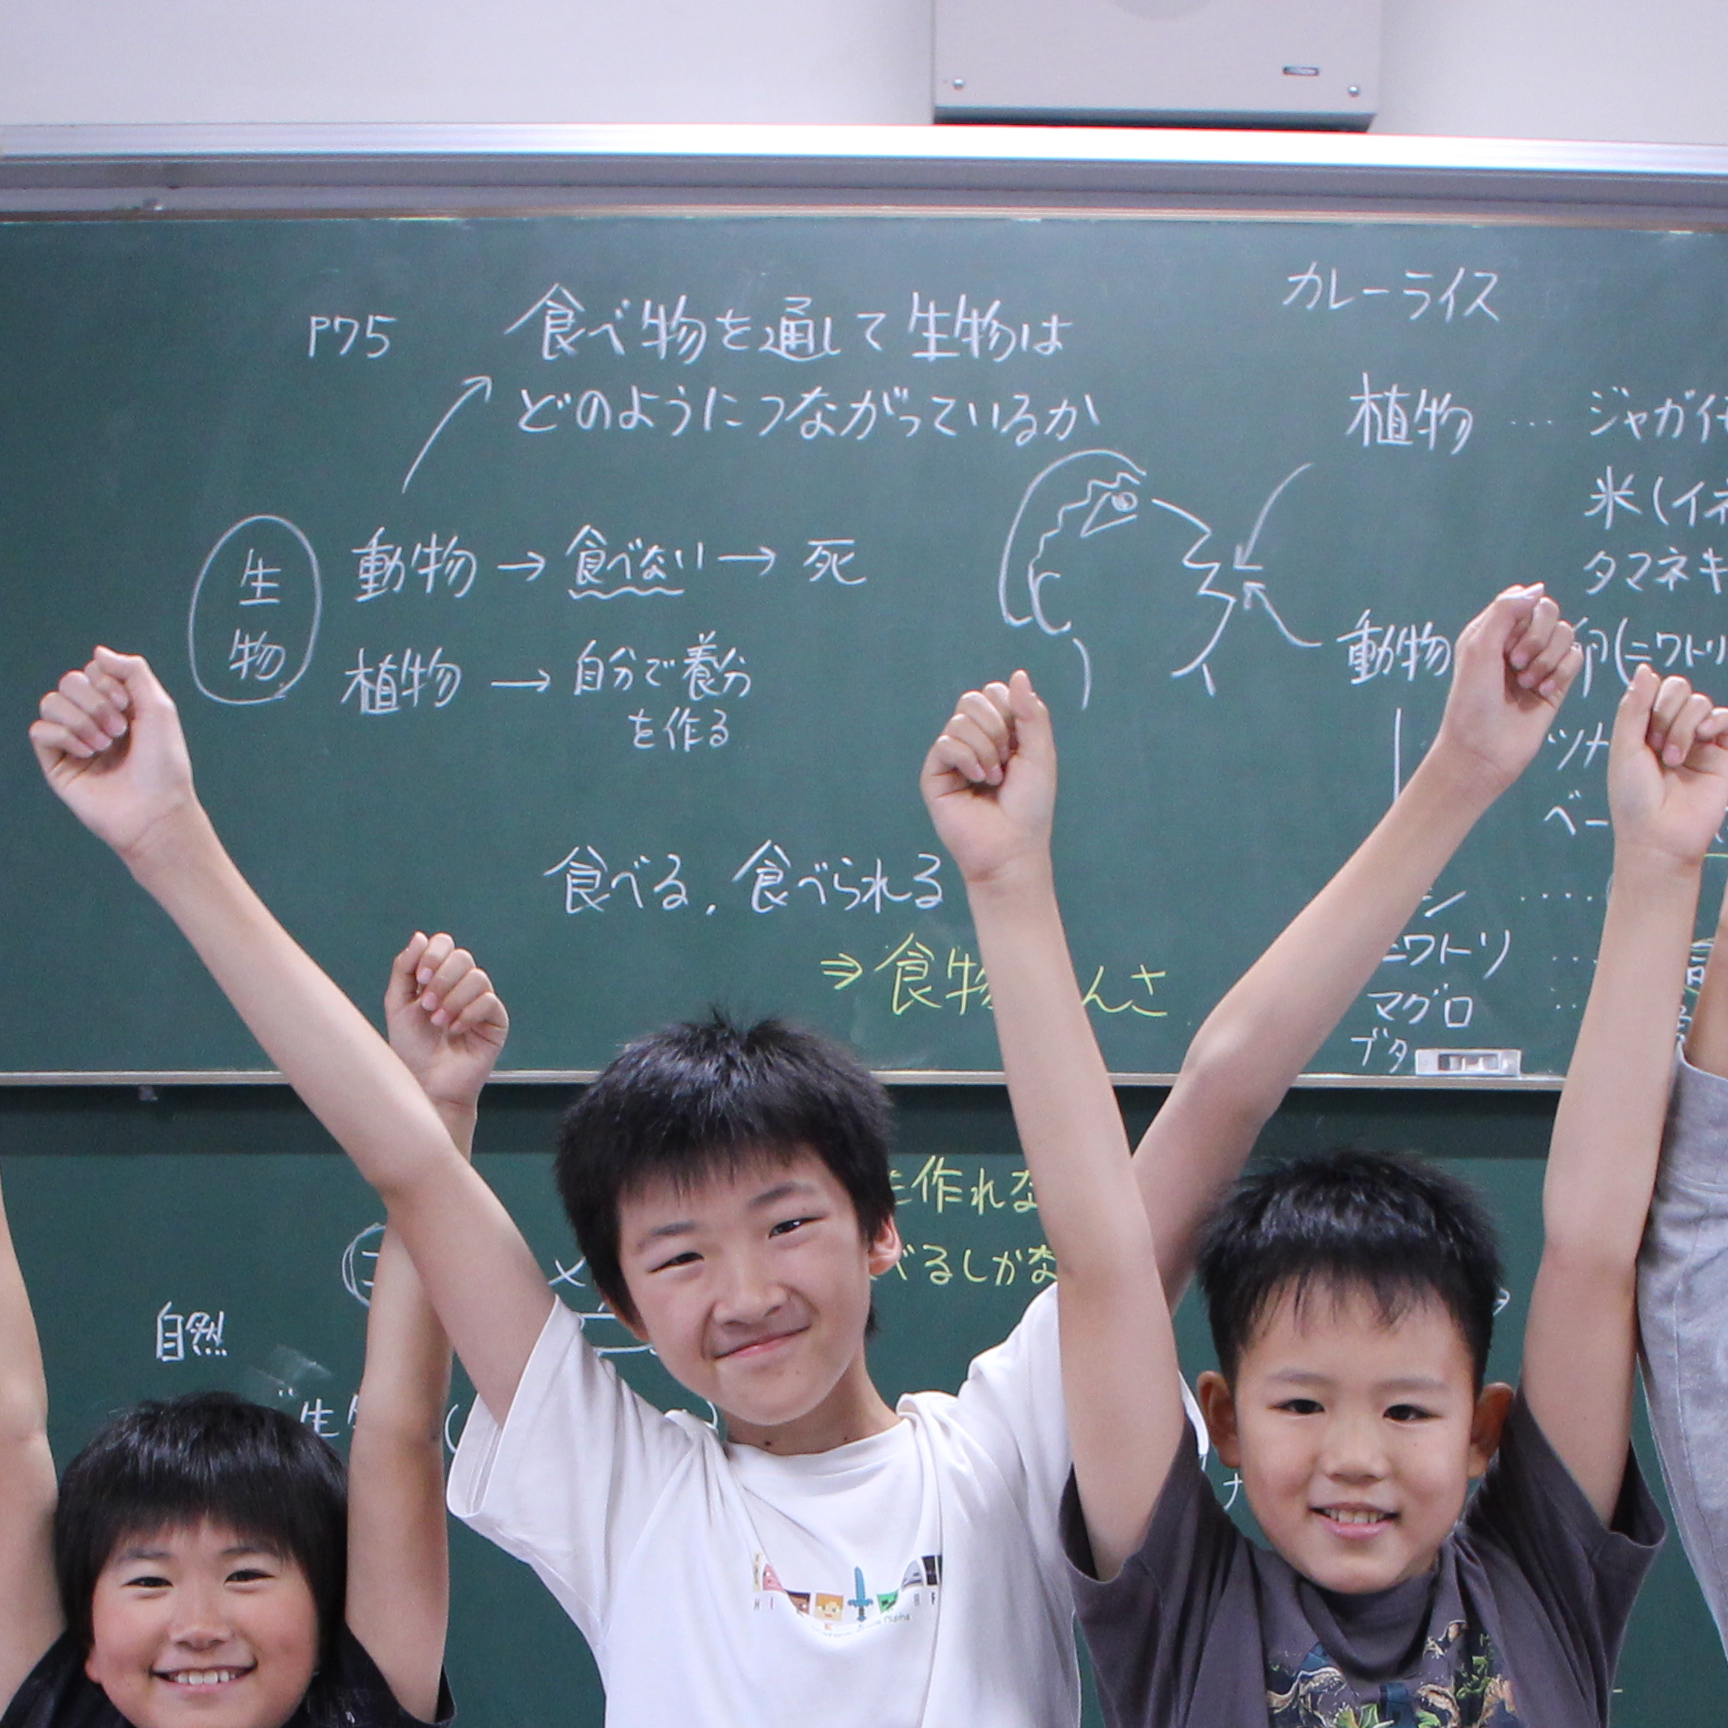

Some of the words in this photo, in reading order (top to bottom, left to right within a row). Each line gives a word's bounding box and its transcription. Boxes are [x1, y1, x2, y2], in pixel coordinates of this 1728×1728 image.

[1282, 264, 1501, 324] カレーライス
[308, 314, 397, 359] P75
[517, 386, 1101, 448] どのようにつながっているか
[1348, 371, 1475, 453] 植物
[355, 526, 477, 603] 動物
[566, 523, 708, 588] 食べない
[802, 538, 869, 586] 死
[1335, 607, 1453, 686] 動物
[340, 646, 464, 718] 植物
[628, 706, 731, 752] を作る
[1367, 982, 1473, 1029] マグロ
[1350, 1027, 1409, 1074] ブタ
[155, 1300, 229, 1362] 自然
